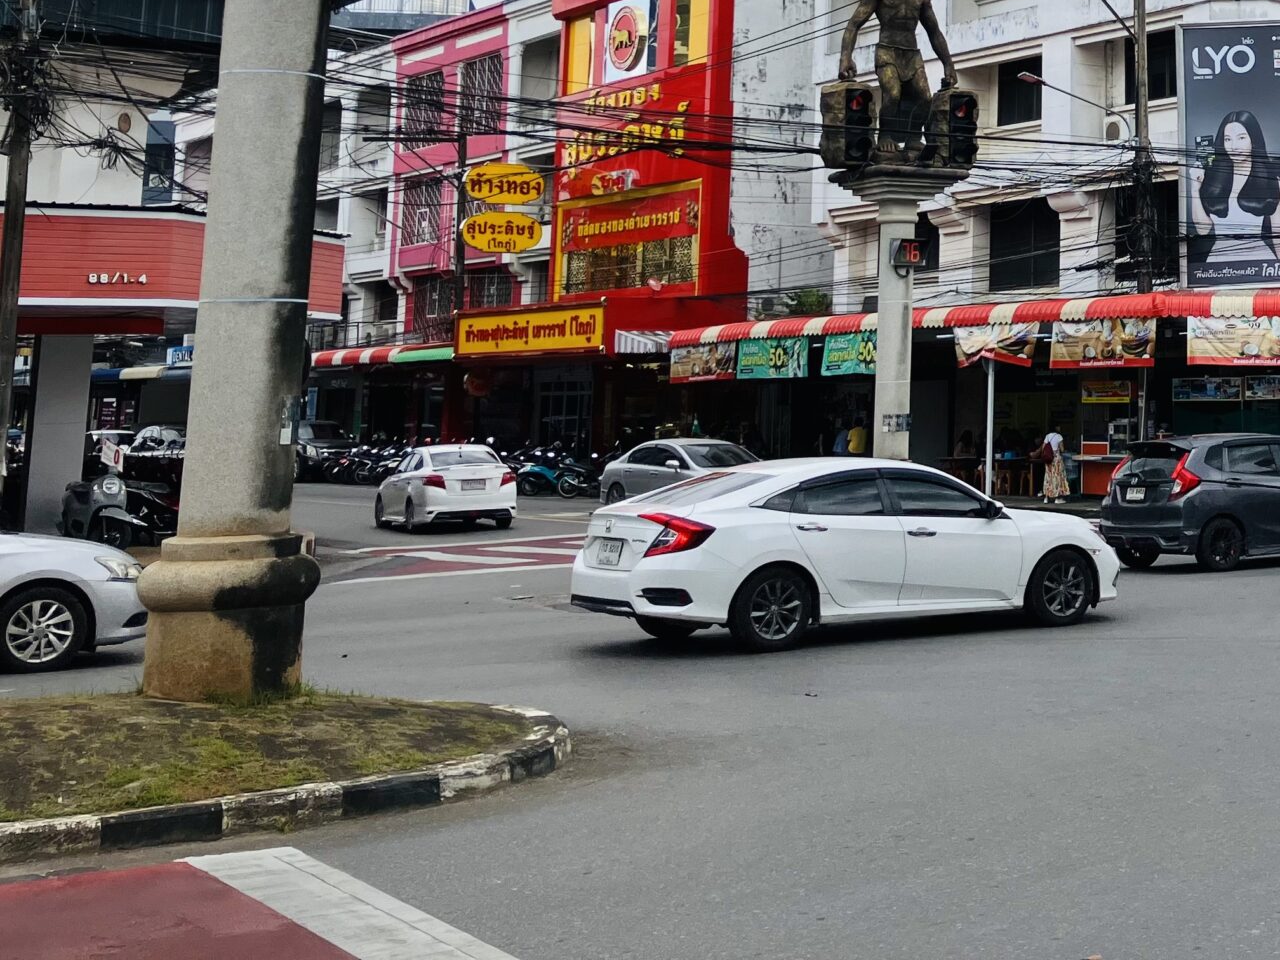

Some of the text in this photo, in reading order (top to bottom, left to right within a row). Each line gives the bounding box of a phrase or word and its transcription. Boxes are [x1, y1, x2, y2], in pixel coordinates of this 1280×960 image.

[1191, 44, 1256, 75] LYO
[470, 173, 542, 196] ห้างทอง
